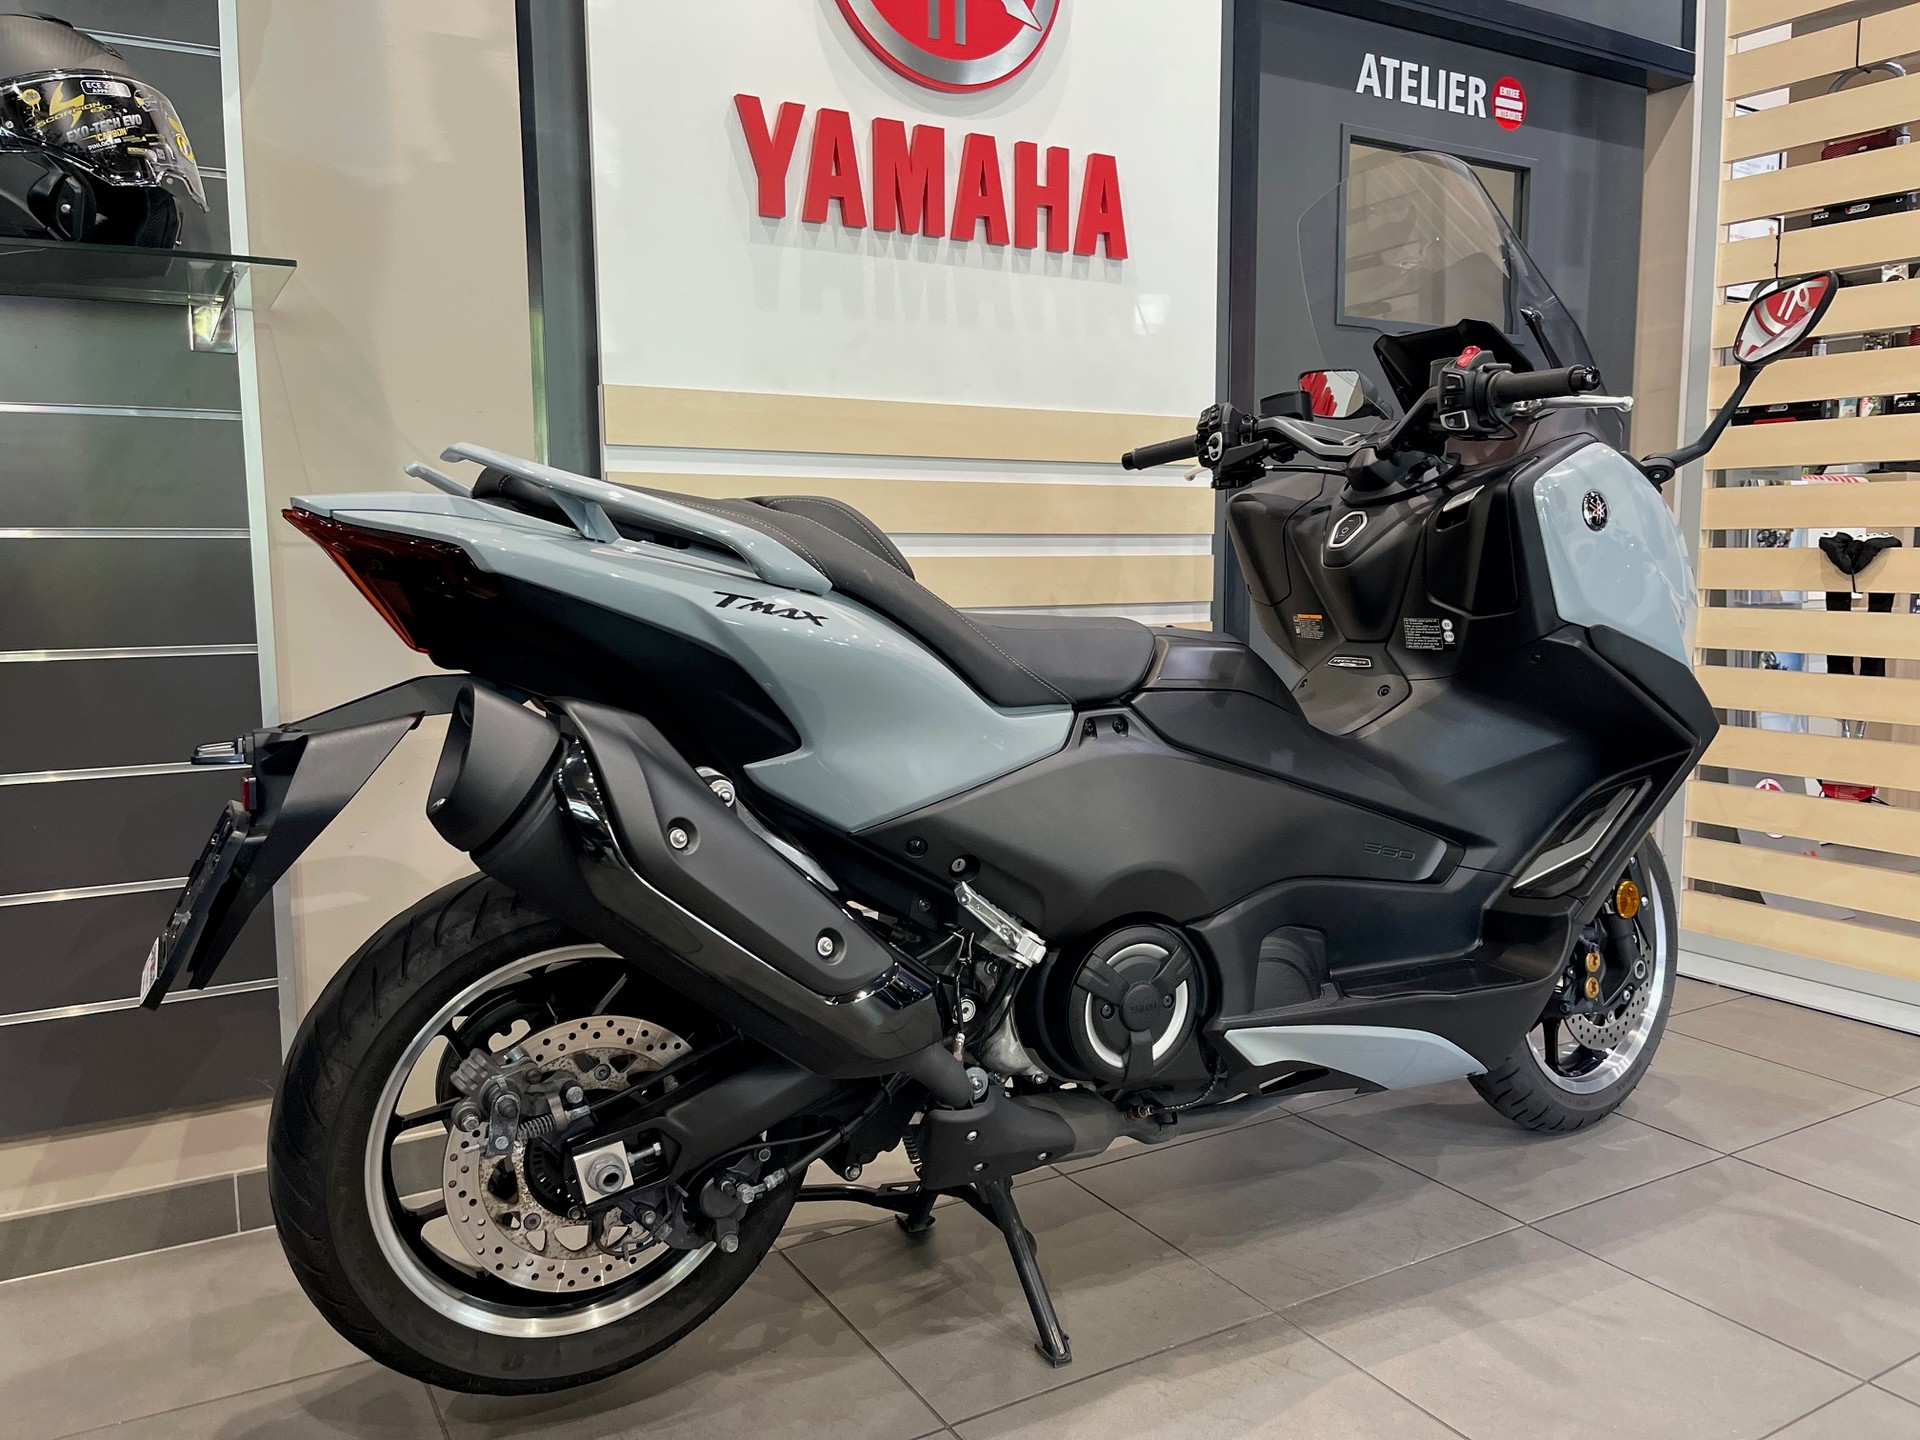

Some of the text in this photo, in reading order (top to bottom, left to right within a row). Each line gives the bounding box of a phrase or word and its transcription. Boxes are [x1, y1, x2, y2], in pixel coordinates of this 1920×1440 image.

[1355, 52, 1487, 119] ATELIER
[90, 104, 112, 113] EXO
[66, 117, 121, 142] EXO-TECH
[123, 113, 143, 126] EVO
[734, 93, 1129, 260] YAMAHA
[713, 591, 829, 627] TMAX
